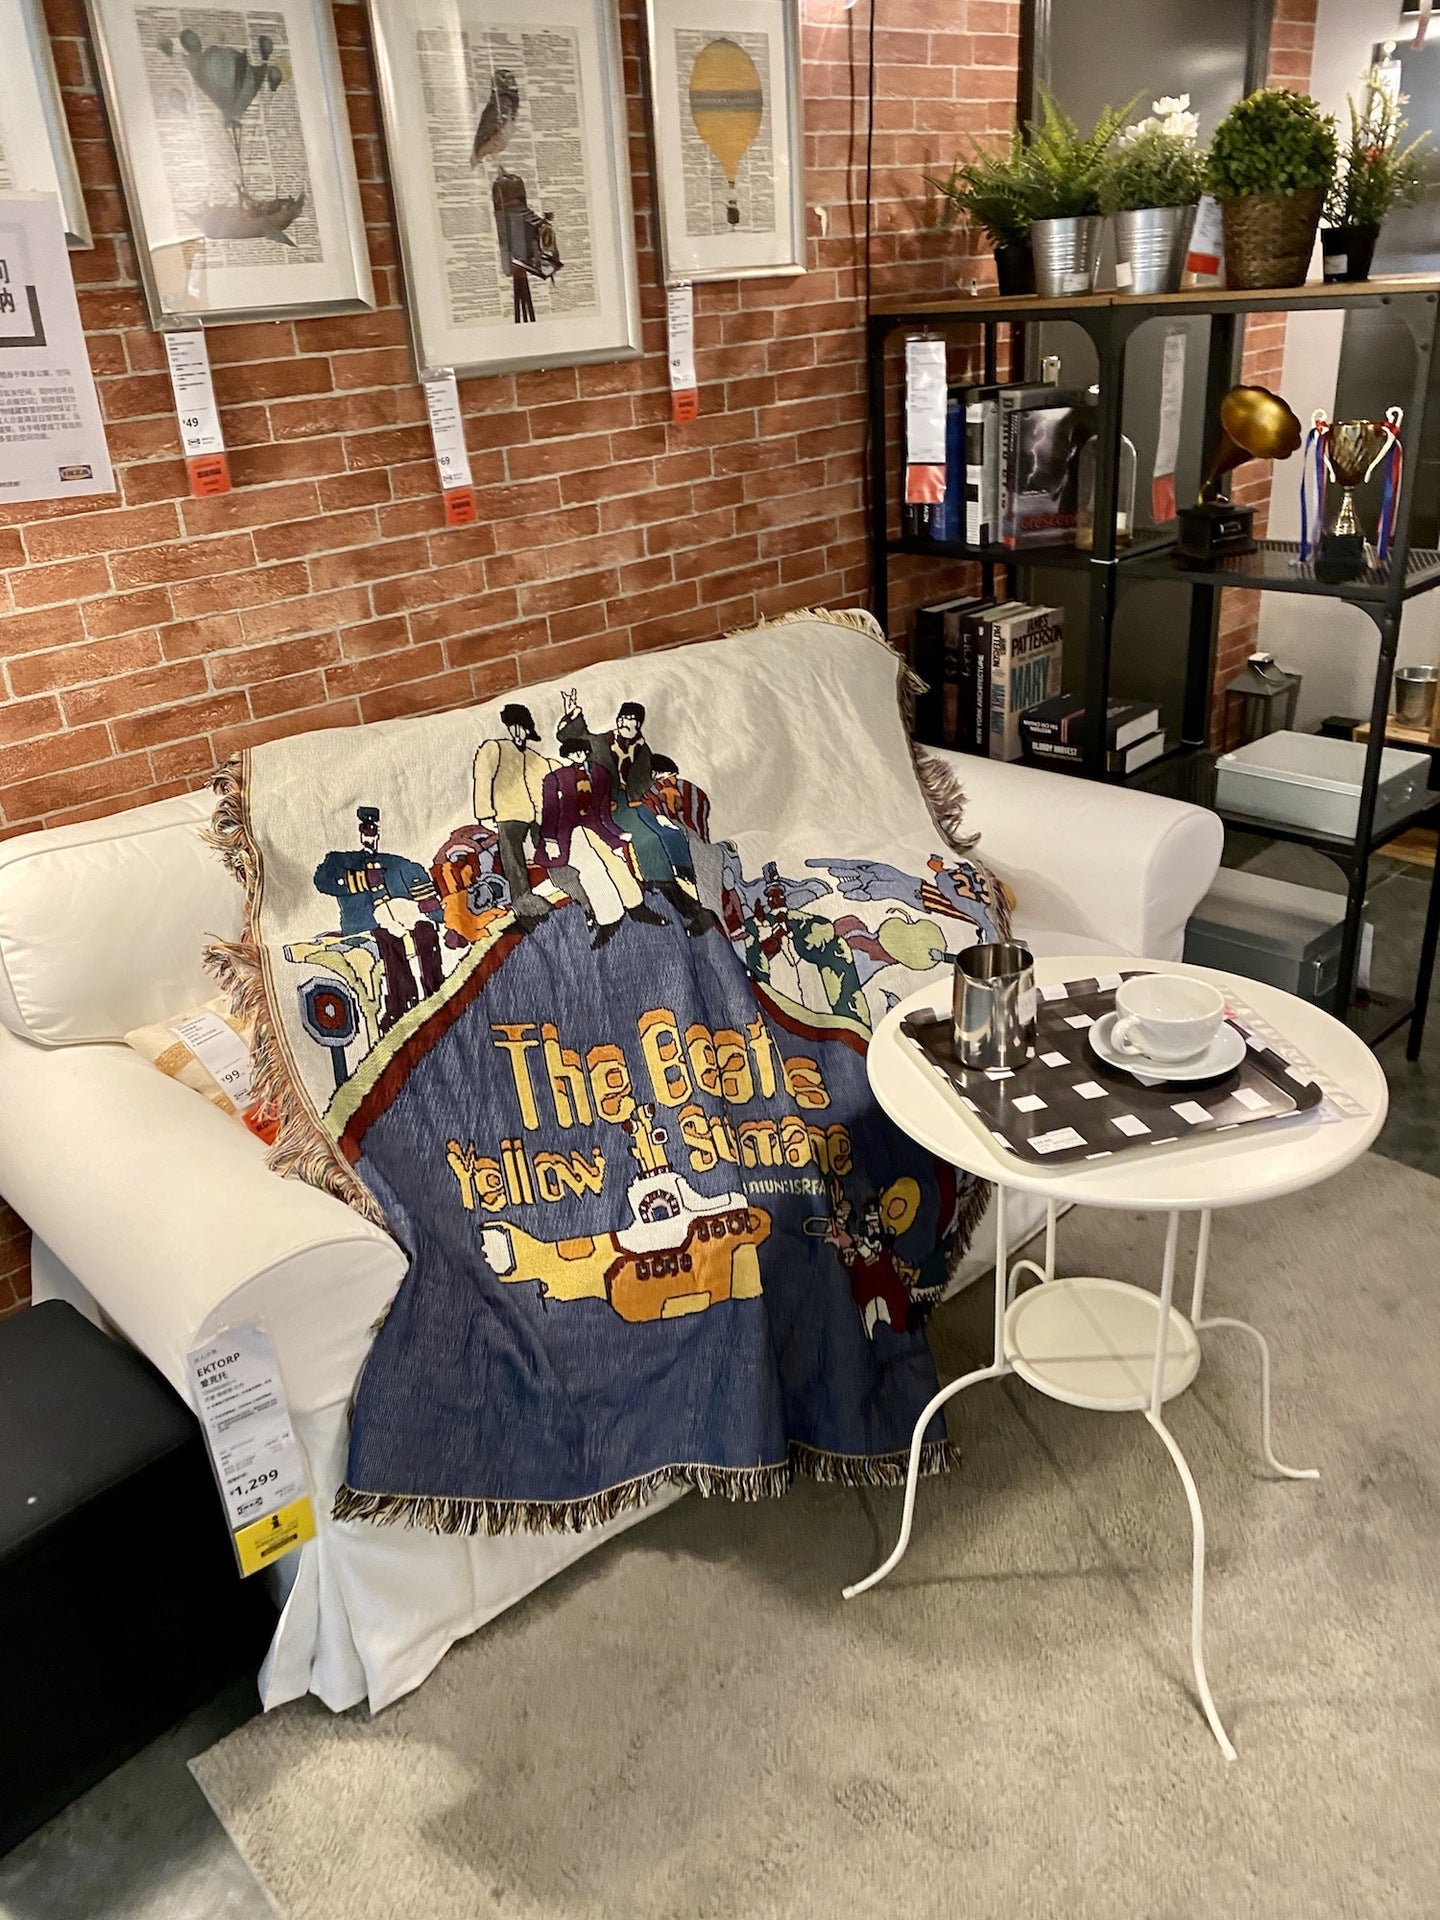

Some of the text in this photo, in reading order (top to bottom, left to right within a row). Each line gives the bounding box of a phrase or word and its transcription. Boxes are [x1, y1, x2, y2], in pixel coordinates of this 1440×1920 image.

[993, 624, 1001, 668] PATTERSON
[1011, 623, 1063, 658] PATTERSON
[1026, 613, 1049, 635] JAMES
[976, 654, 985, 707] ARCHITECTURE
[491, 1022, 636, 1131] The
[446, 1138, 606, 1213] Yellow
[196, 1352, 240, 1377] EKTORP
